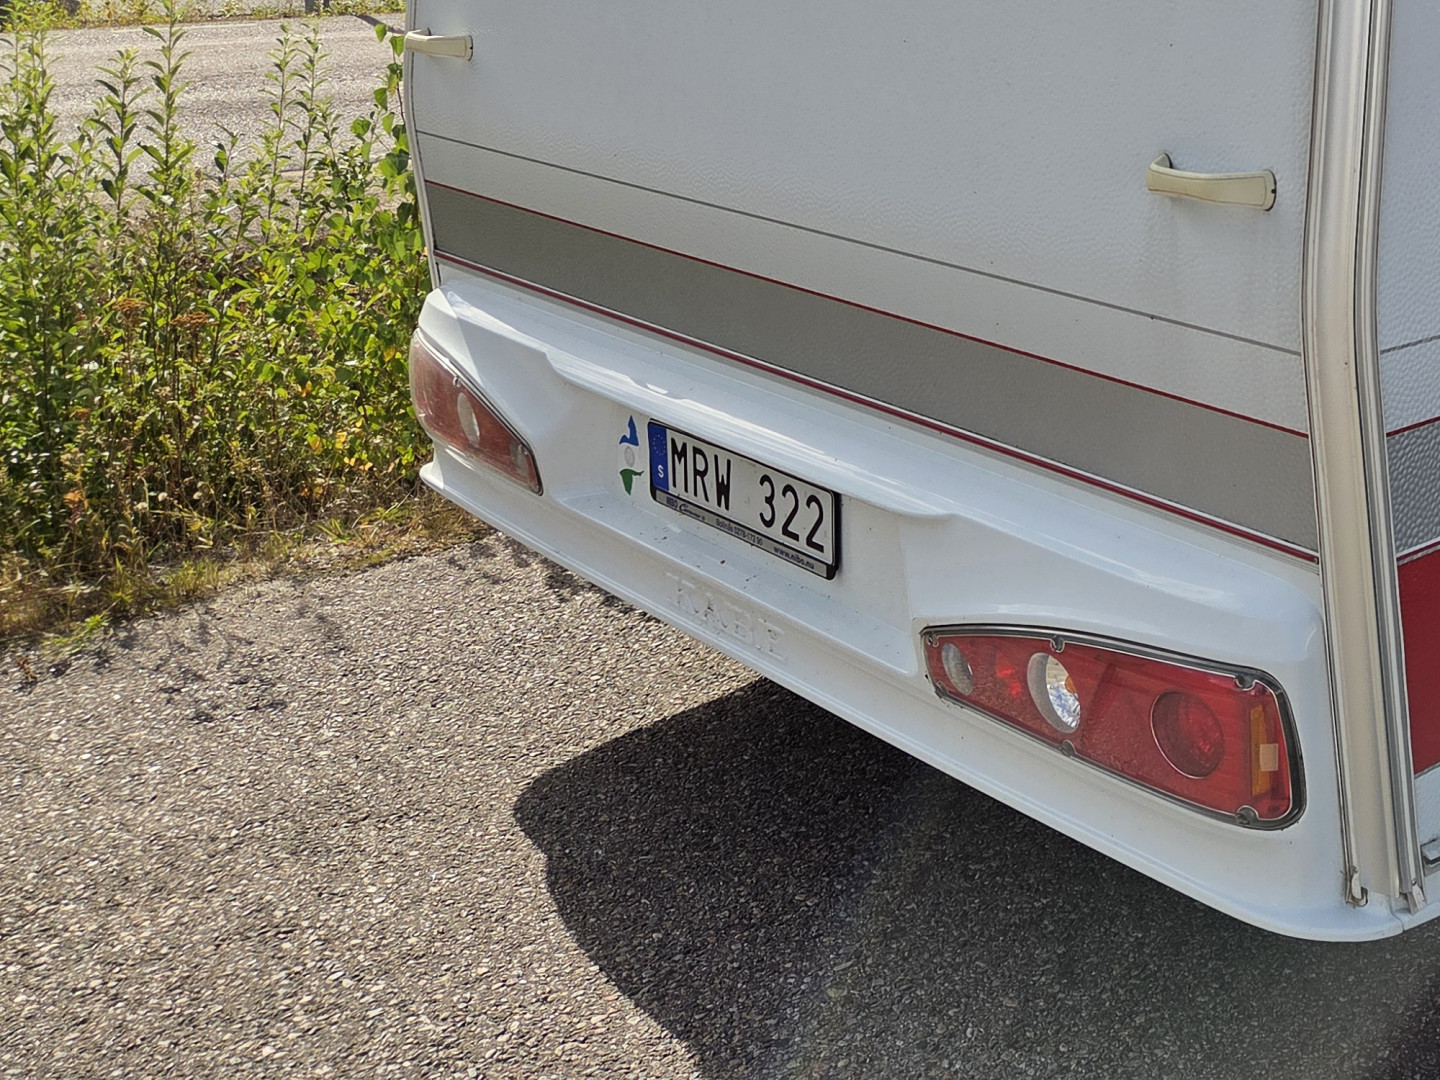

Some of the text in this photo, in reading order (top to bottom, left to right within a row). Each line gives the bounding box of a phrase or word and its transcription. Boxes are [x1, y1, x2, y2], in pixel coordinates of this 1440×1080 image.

[657, 465, 665, 479] S
[671, 437, 825, 554] MRW 322
